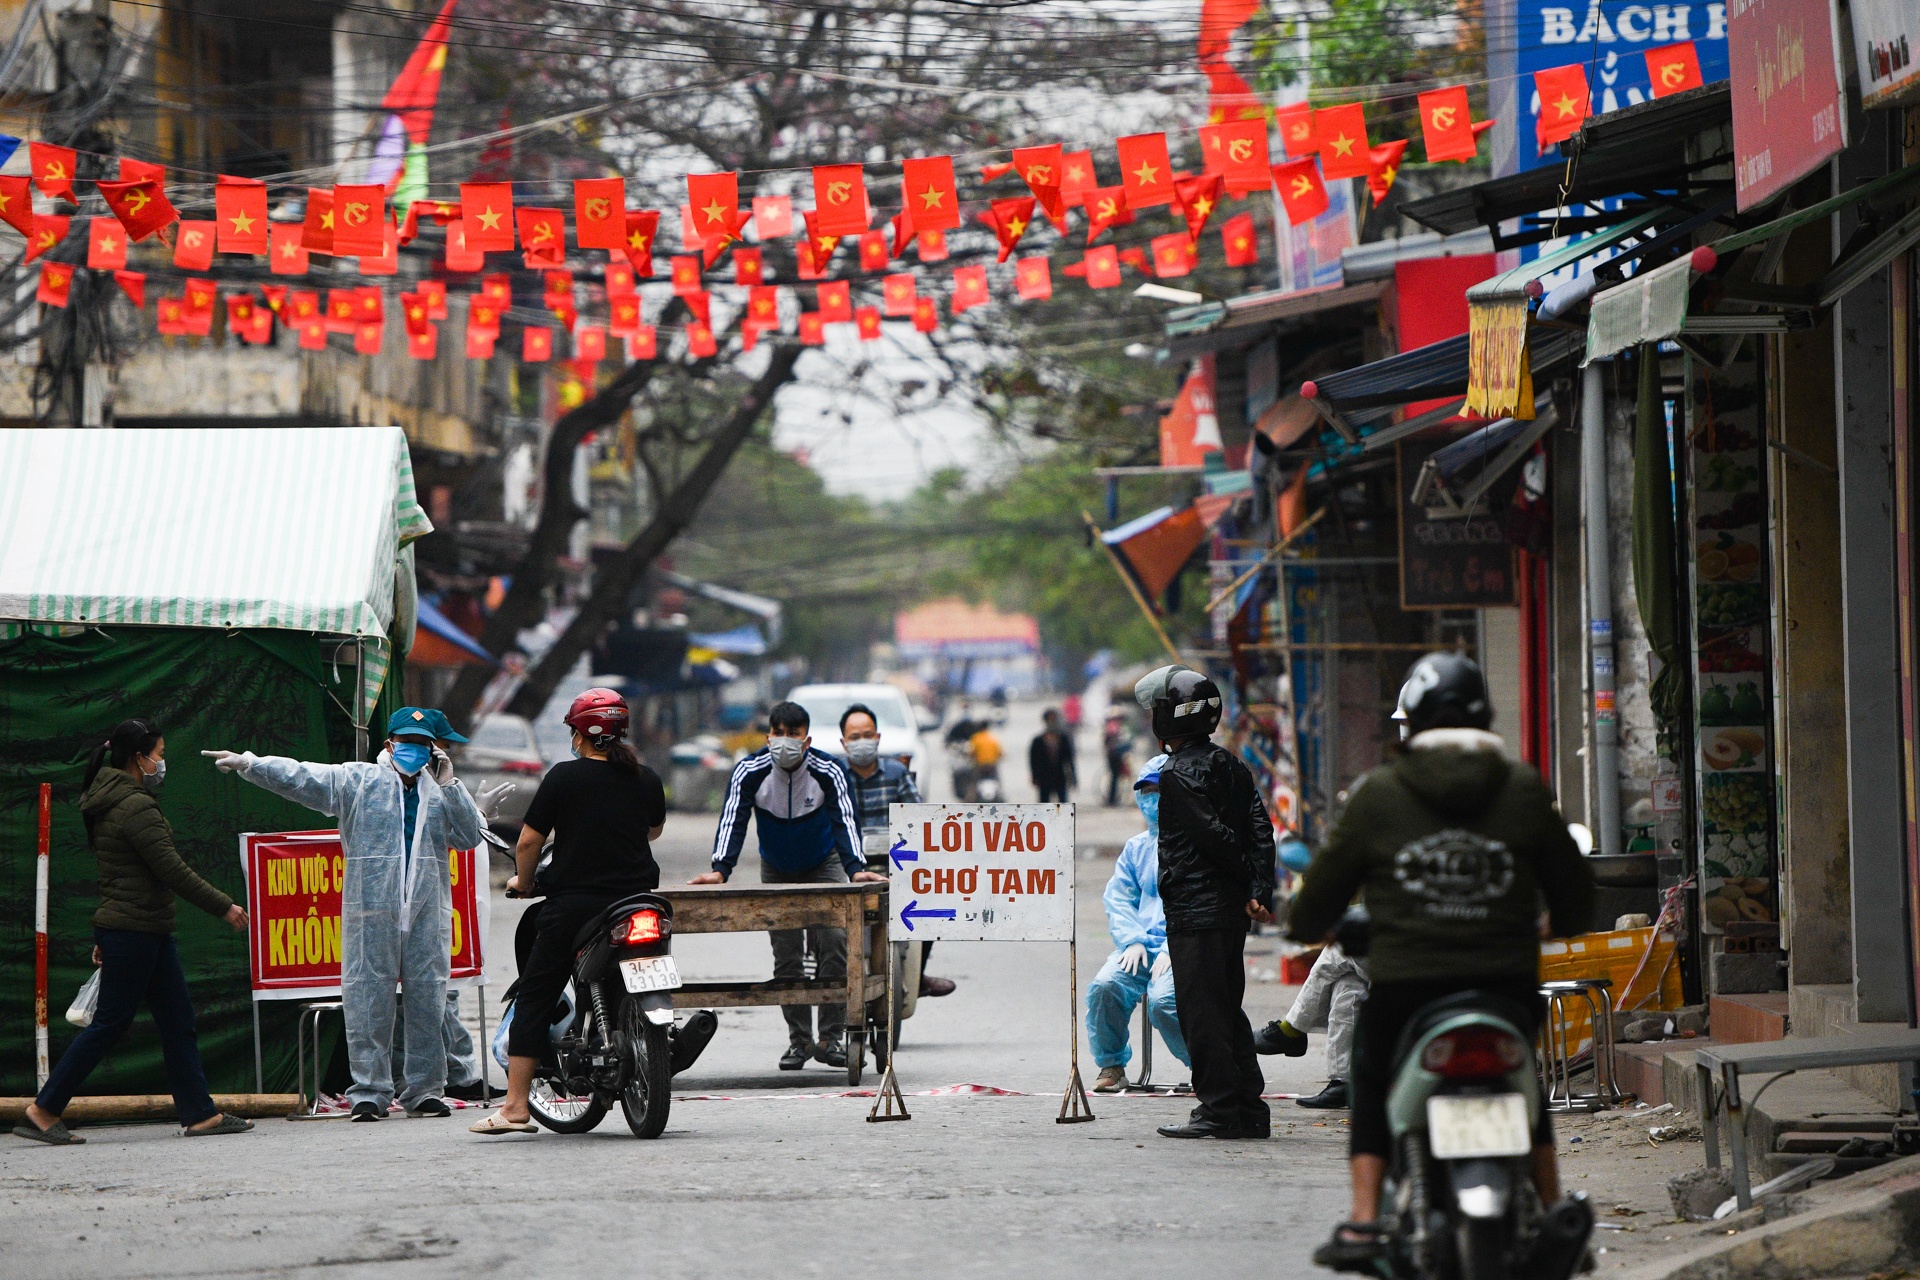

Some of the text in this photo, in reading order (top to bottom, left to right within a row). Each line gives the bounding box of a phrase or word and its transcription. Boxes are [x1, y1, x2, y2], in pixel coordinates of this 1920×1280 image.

[1540, 0, 1691, 44] BÁCH
[923, 812, 1046, 852] LỐI VÀO
[267, 858, 297, 896] KHU
[300, 853, 329, 903] VỰC
[911, 865, 1056, 903] CHỢ TẠM
[629, 959, 668, 975] 34-C1
[629, 972, 678, 990] 431.38
